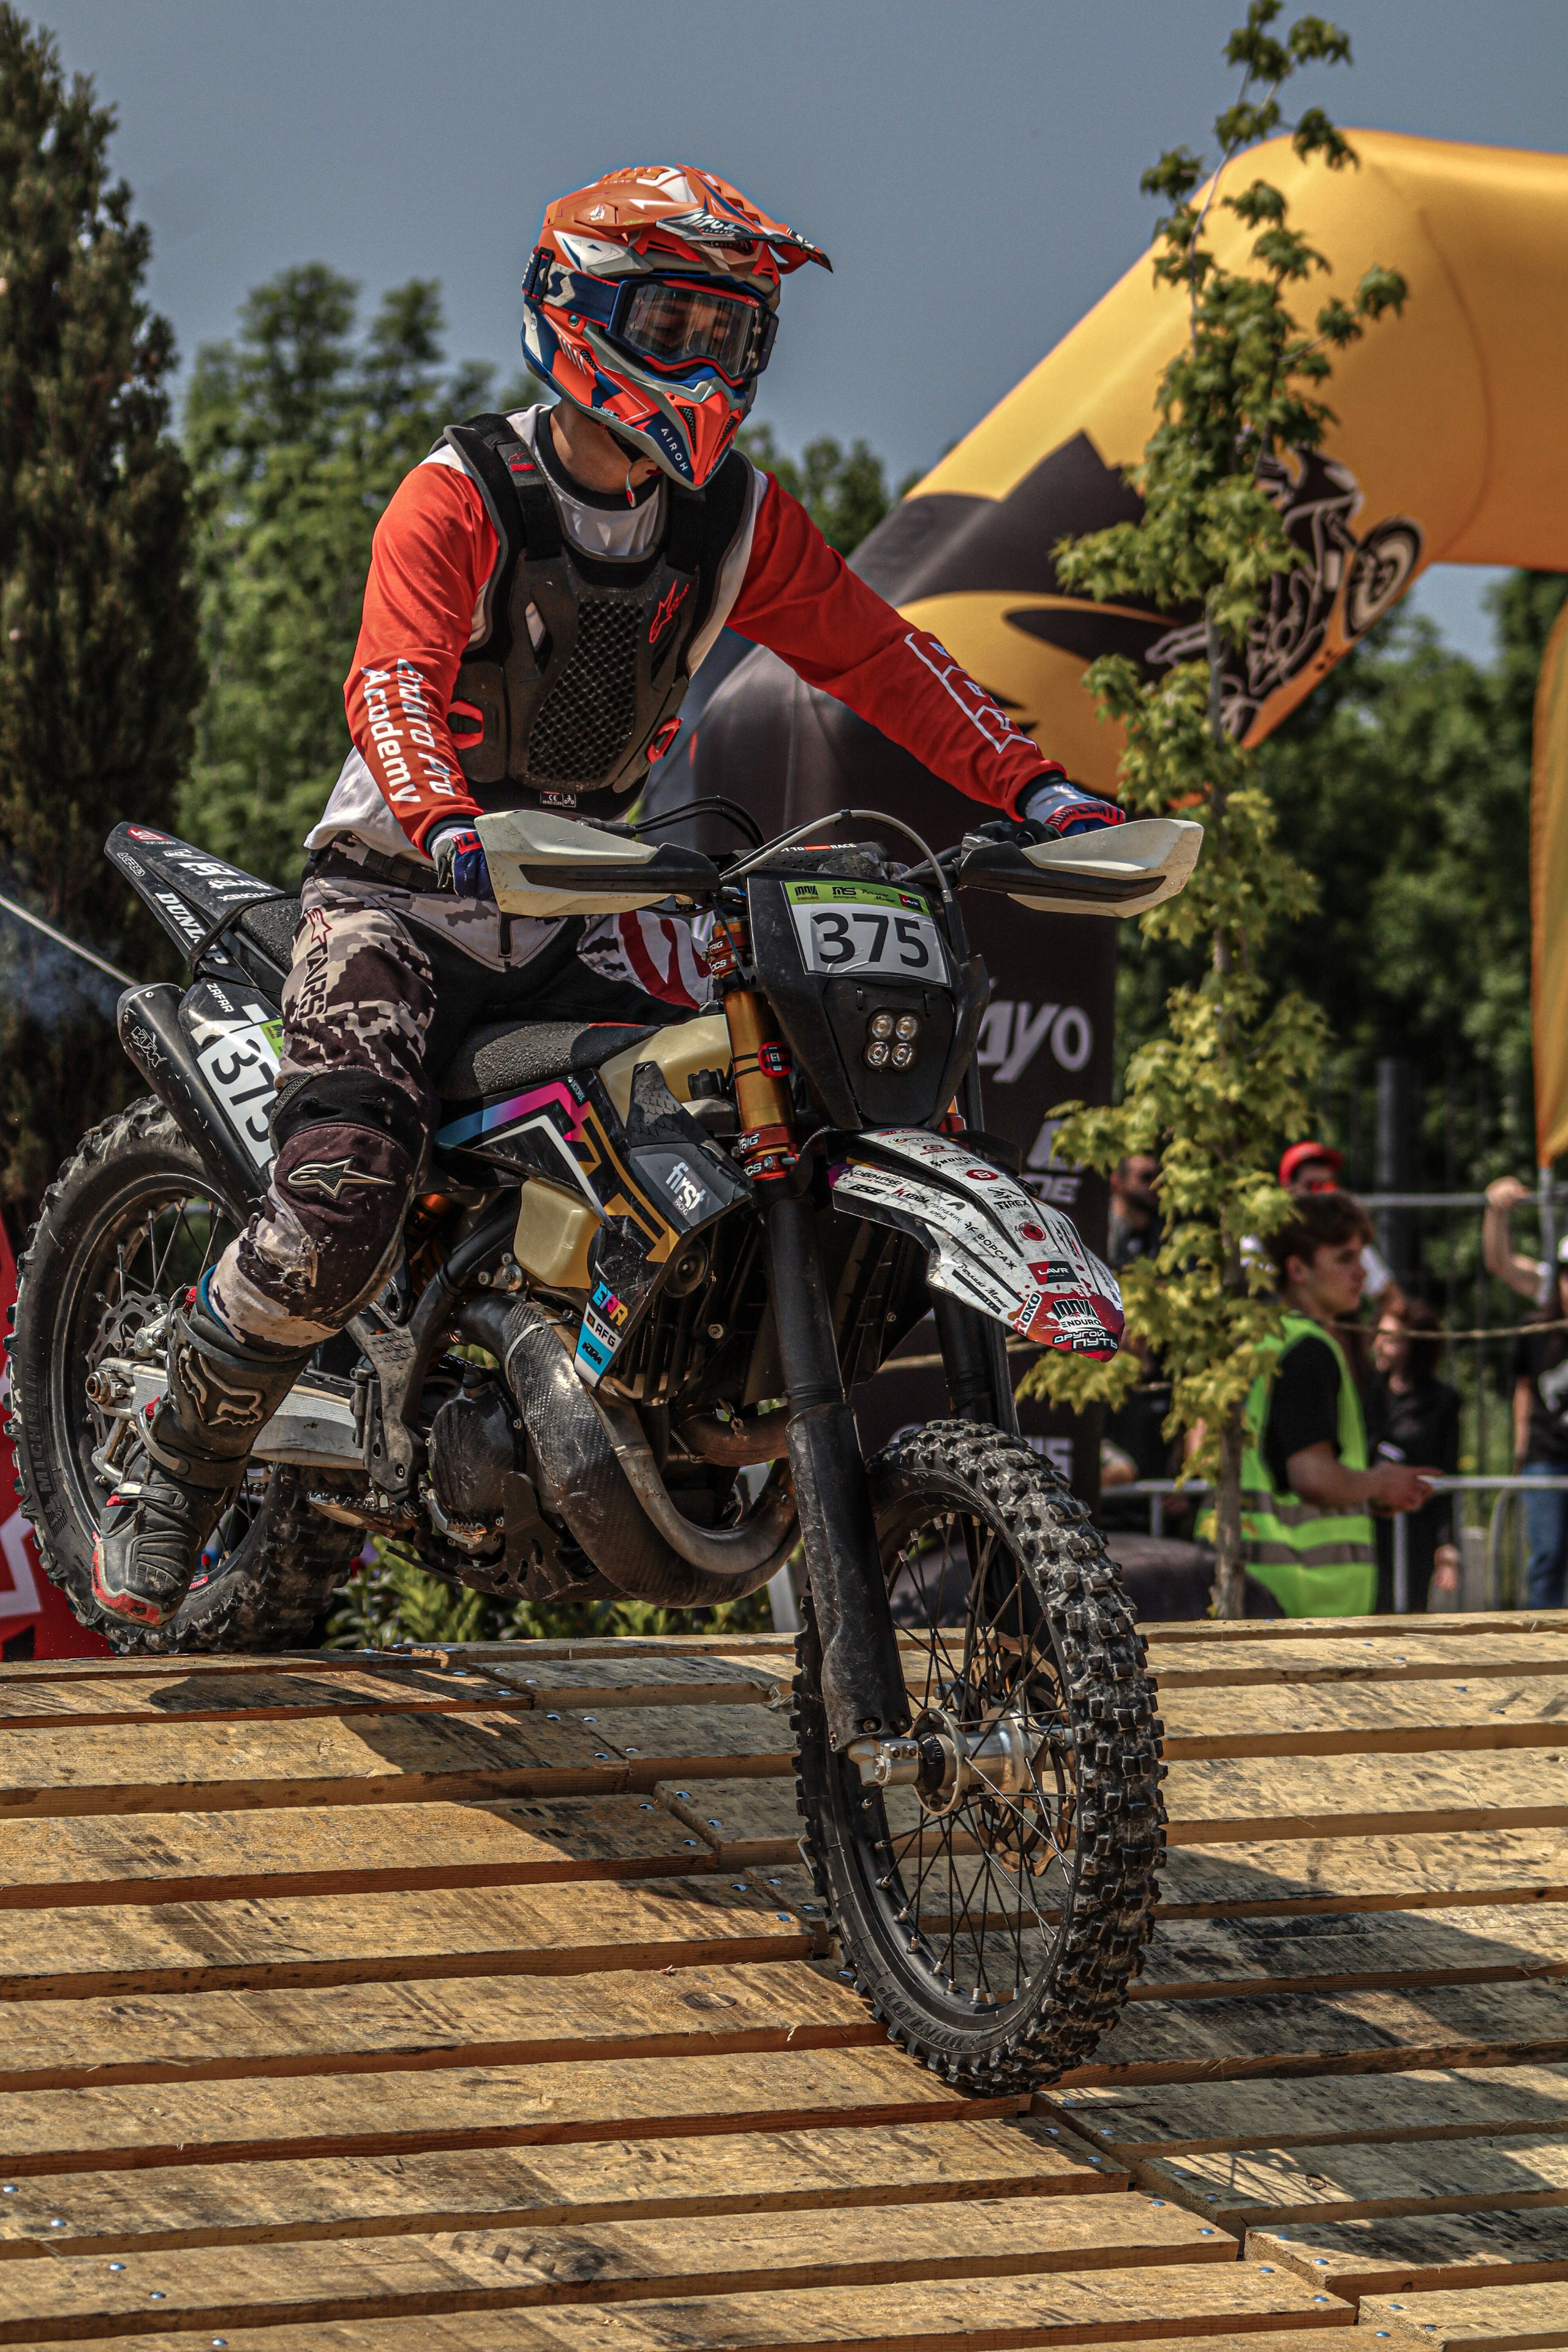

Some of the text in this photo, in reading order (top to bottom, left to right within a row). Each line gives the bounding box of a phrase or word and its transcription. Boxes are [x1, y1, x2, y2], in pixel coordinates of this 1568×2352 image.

[661, 428, 688, 471] AIROH
[360, 667, 421, 803] Academy
[812, 912, 929, 968] 375
[206, 982, 234, 1013] ZAFAR
[131, 1025, 167, 1068] KTM
[665, 1162, 706, 1210] first
[903, 1193, 930, 1204] KENDA
[977, 1234, 1017, 1270] ФОРСАЖ
[595, 1322, 616, 1348] AFG
[1054, 1330, 1105, 1343] ДРУГОЙ
[1060, 1319, 1101, 1328] ENDURO
[582, 1341, 603, 1366] KTM
[1073, 1338, 1118, 1350] ПУТЬ
[26, 1360, 52, 1493] MICHELIN
[876, 1985, 968, 2051] DUNLOP
